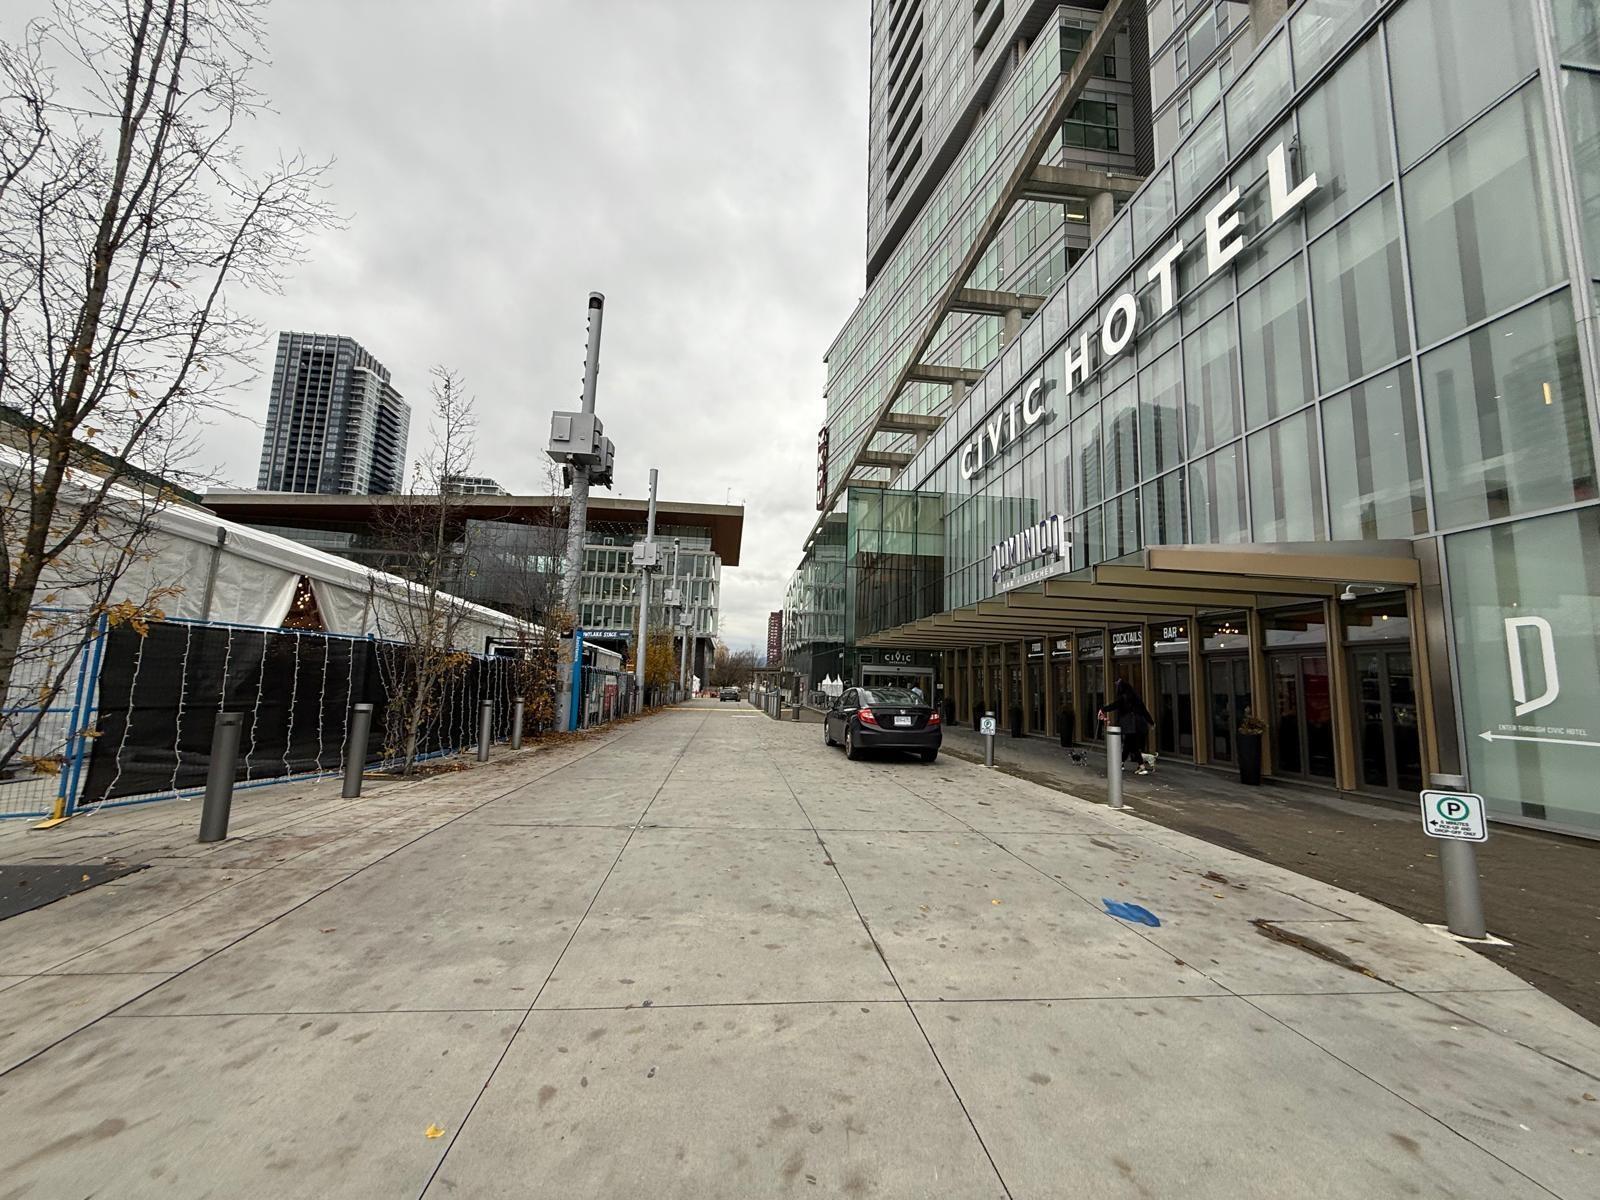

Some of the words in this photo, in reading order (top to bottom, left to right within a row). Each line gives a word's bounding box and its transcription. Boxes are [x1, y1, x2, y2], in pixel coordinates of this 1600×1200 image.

[961, 377, 1045, 480] CIVIC
[1064, 142, 1318, 396] HOTEL
[1023, 567, 1054, 582] KITCHEN
[1112, 631, 1143, 644] COCKTAILS
[1163, 626, 1178, 639] BAR
[884, 651, 911, 662] CIVIC
[1504, 616, 1560, 717] D
[1566, 728, 1587, 736] HOTEL
[1447, 802, 1461, 815] P
